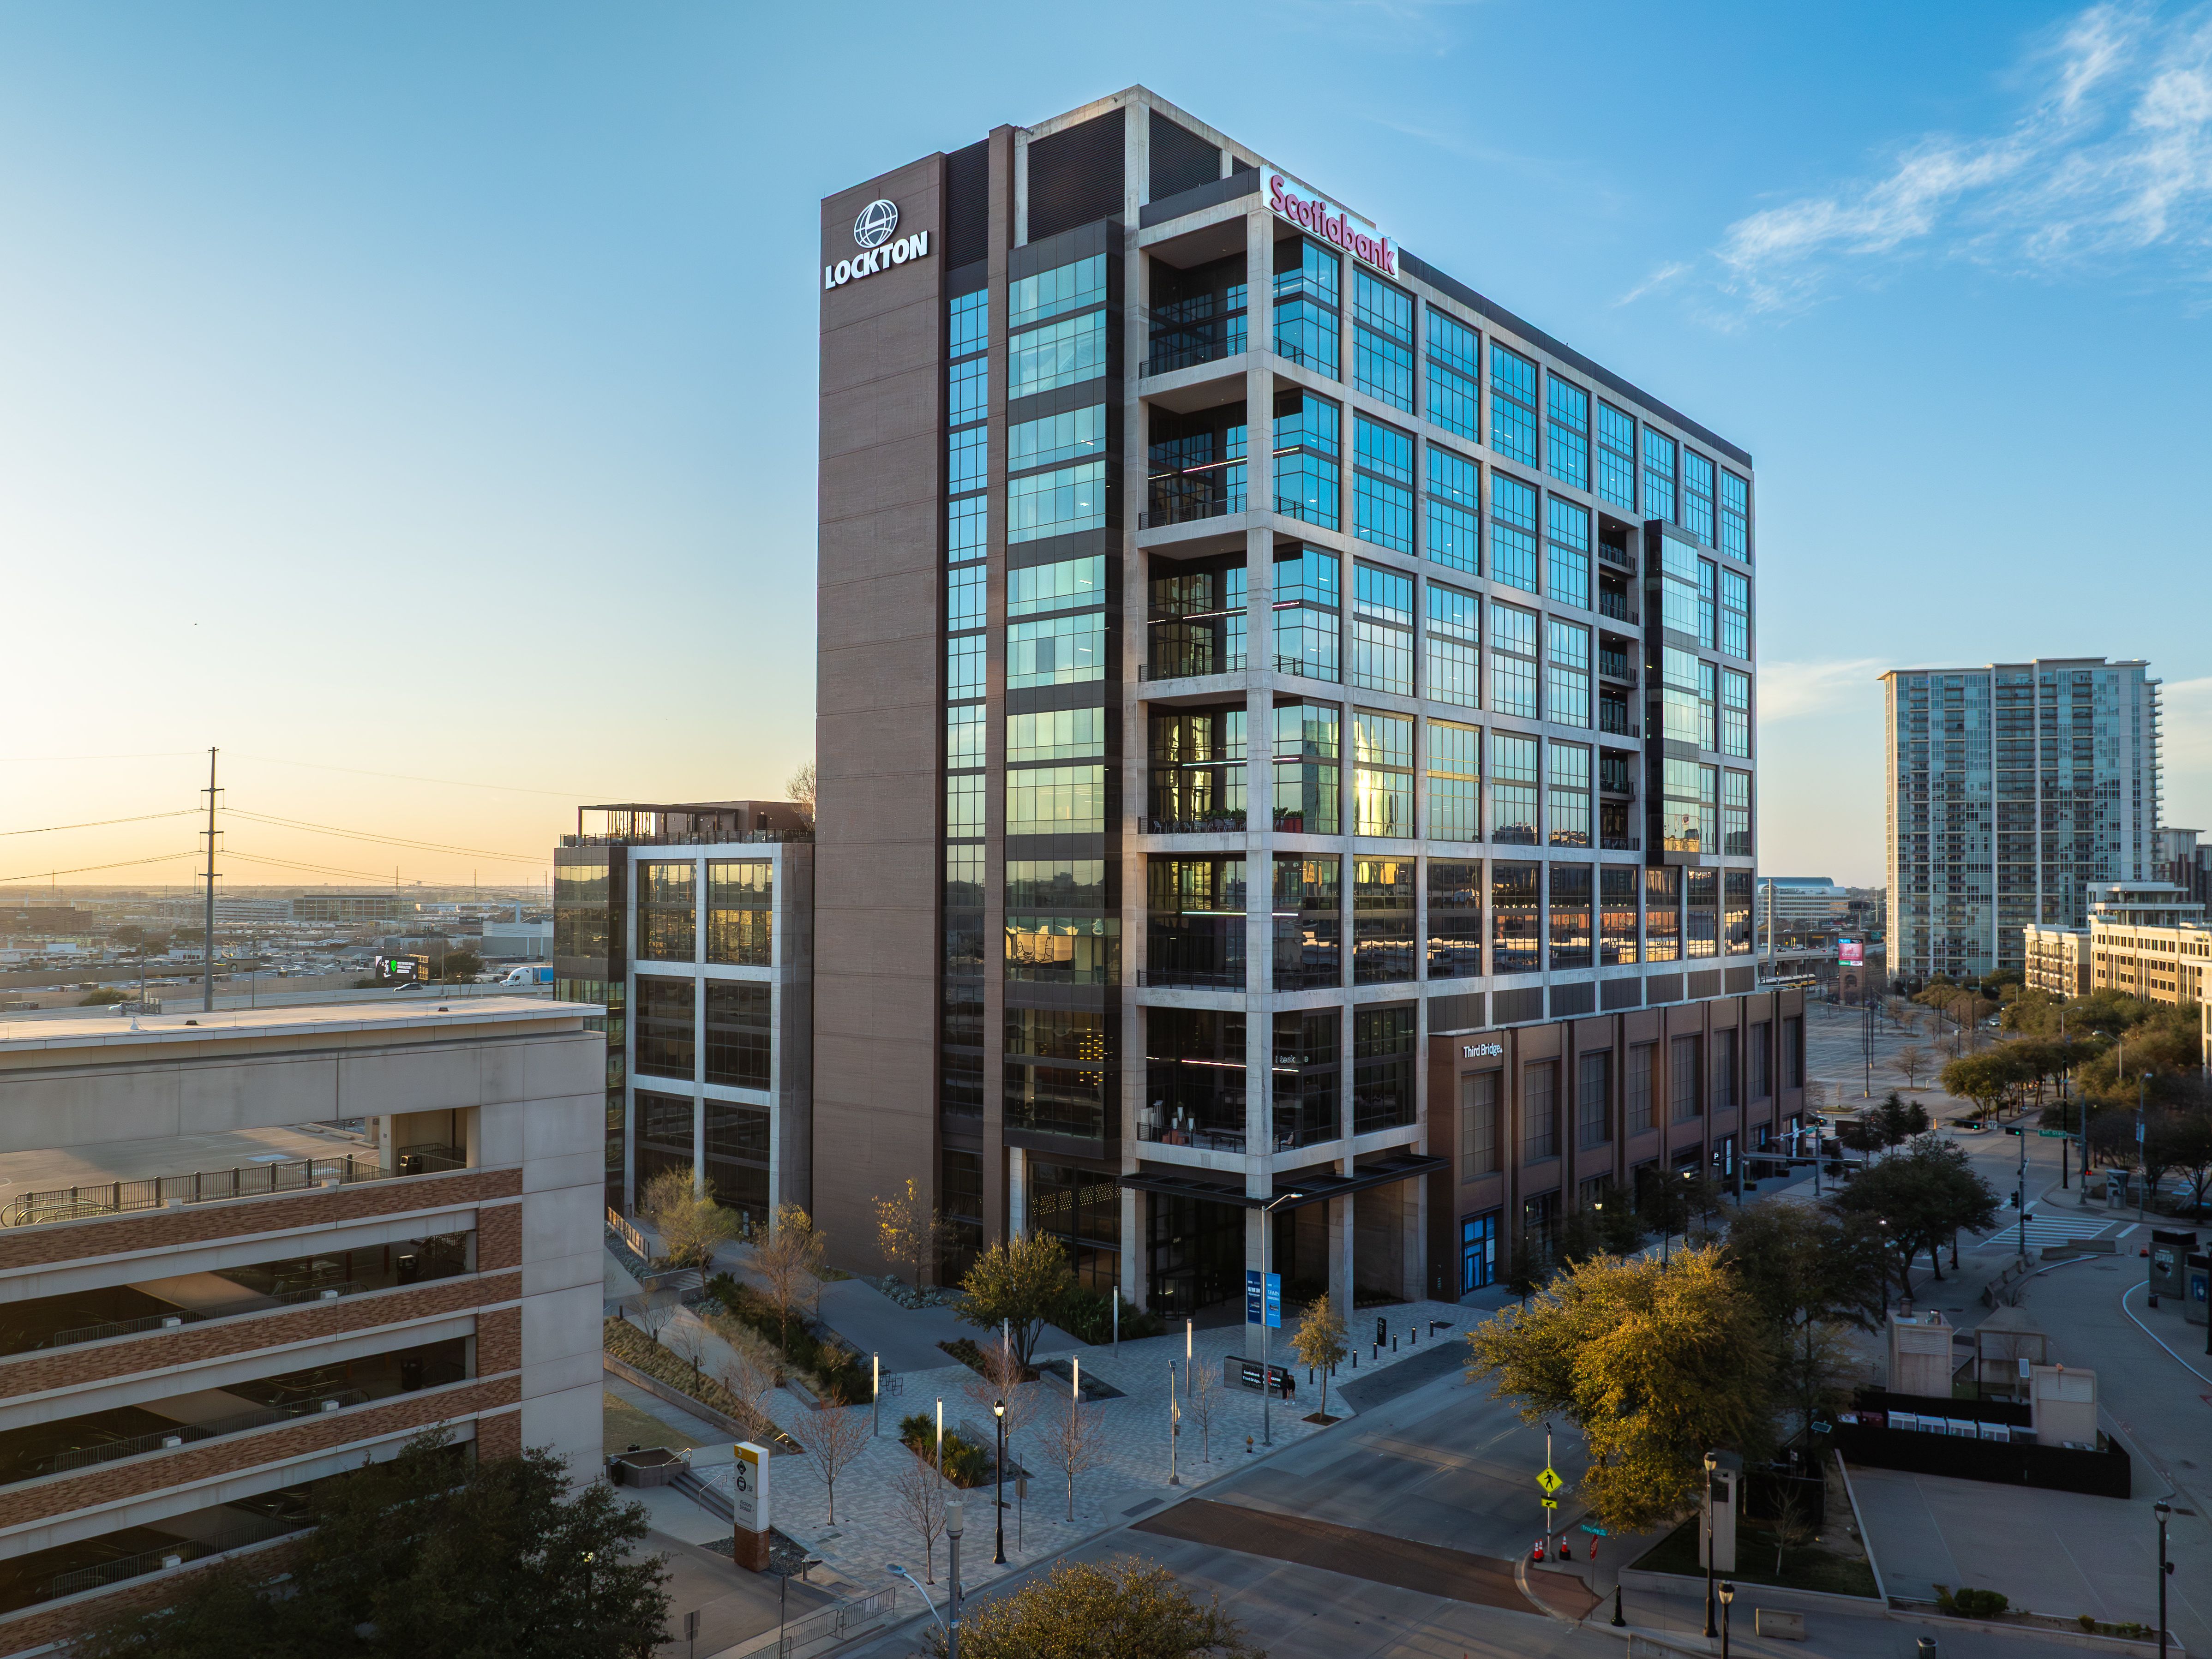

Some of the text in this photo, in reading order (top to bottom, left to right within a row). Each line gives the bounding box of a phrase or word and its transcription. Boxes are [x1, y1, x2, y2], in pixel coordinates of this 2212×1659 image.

[1271, 175, 1395, 275] Scotiabank
[825, 230, 928, 290] LOCKTON
[1463, 1044, 1480, 1058] Third
[739, 1504, 752, 1513] Station
[740, 1499, 752, 1509] Victory
